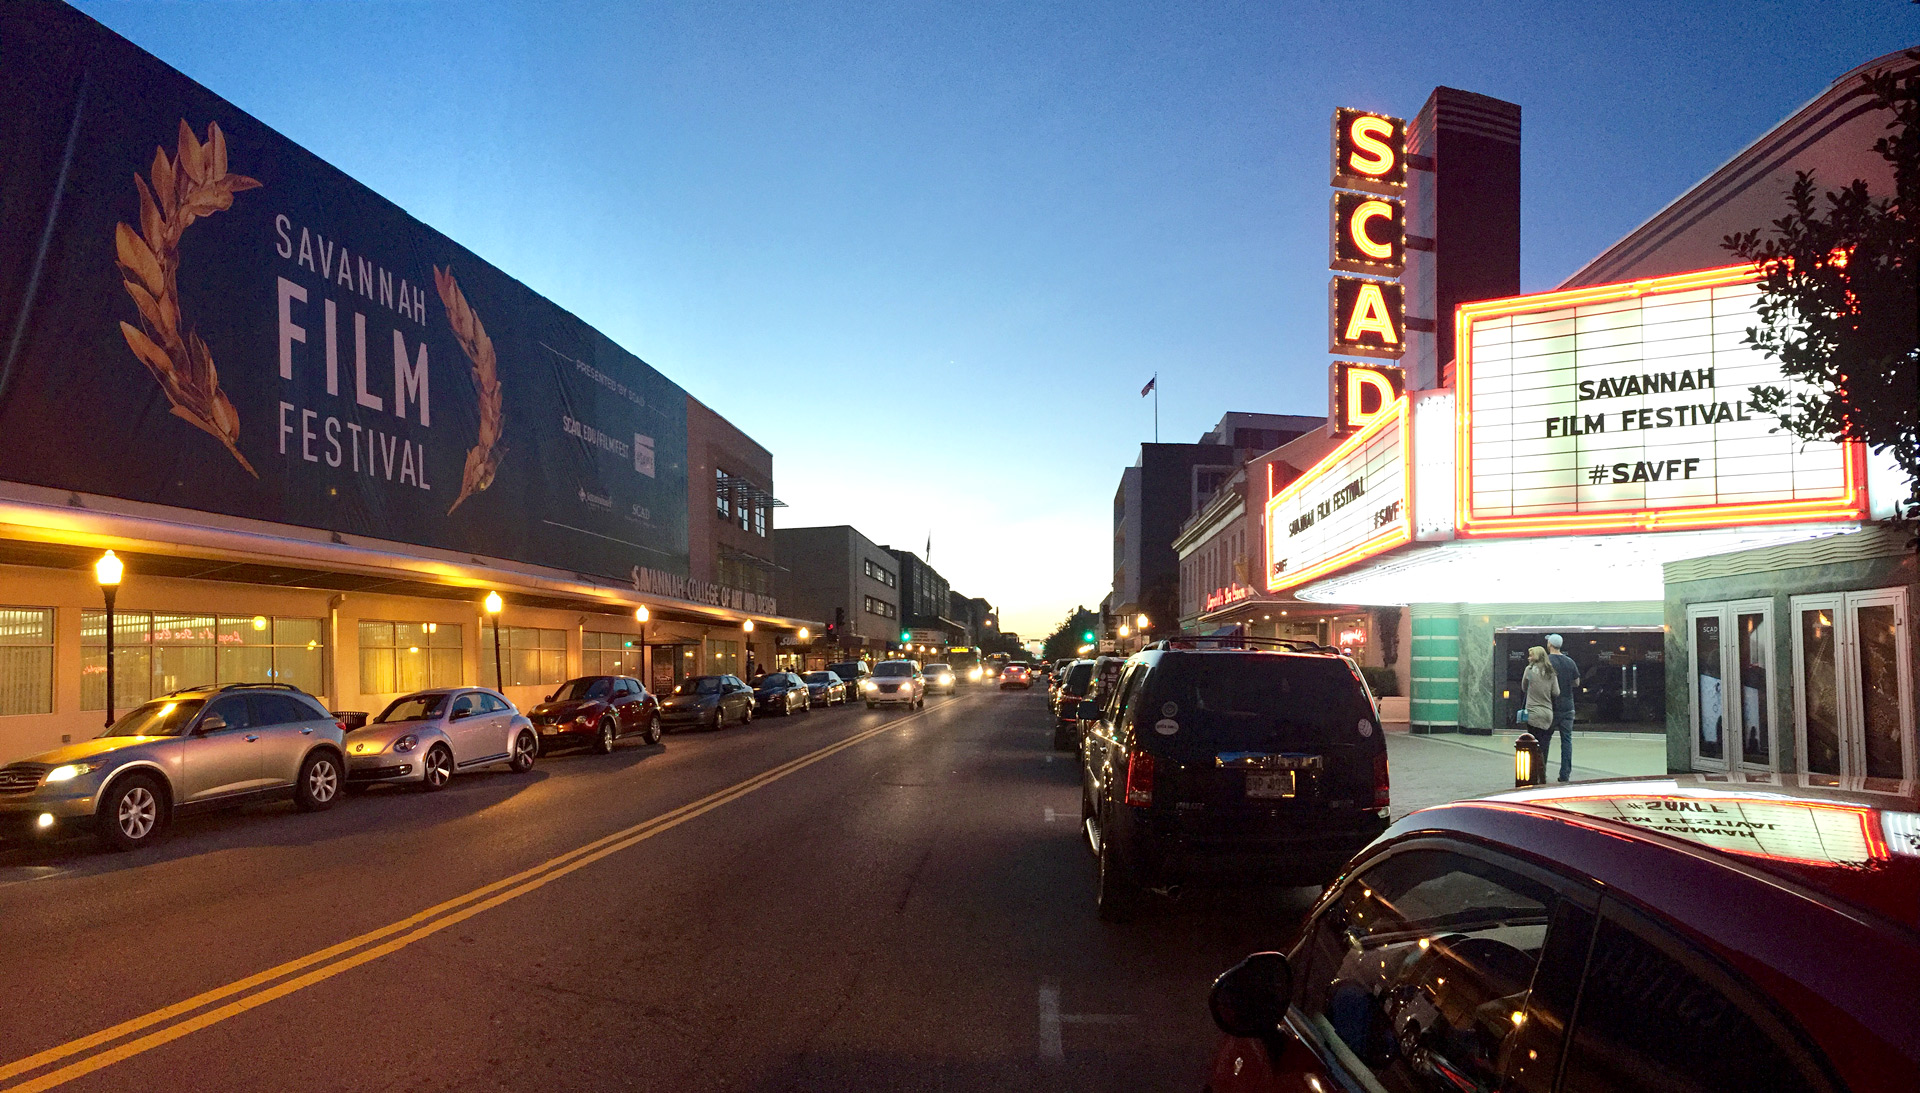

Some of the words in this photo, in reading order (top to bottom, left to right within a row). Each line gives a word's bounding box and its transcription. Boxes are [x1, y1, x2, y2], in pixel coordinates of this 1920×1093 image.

[276, 213, 426, 326] SAVANNAH
[1345, 116, 1398, 427] SCAD
[278, 276, 430, 428] FILM
[1579, 367, 1715, 400] SAVANNAH
[279, 400, 430, 490] FESTIVAL
[1546, 412, 1605, 438] FILM
[1622, 400, 1751, 432] FESTIVAL
[1588, 458, 1700, 485] #SAVFF
[1289, 509, 1315, 538] SAVANNAH
[1317, 498, 1332, 522] FILM
[1333, 476, 1365, 512] FESTIVAL
[631, 565, 685, 598] SAVANNAH
[687, 577, 719, 606] COLLEGE
[720, 586, 731, 607] OF
[758, 595, 777, 616] DESIGN
